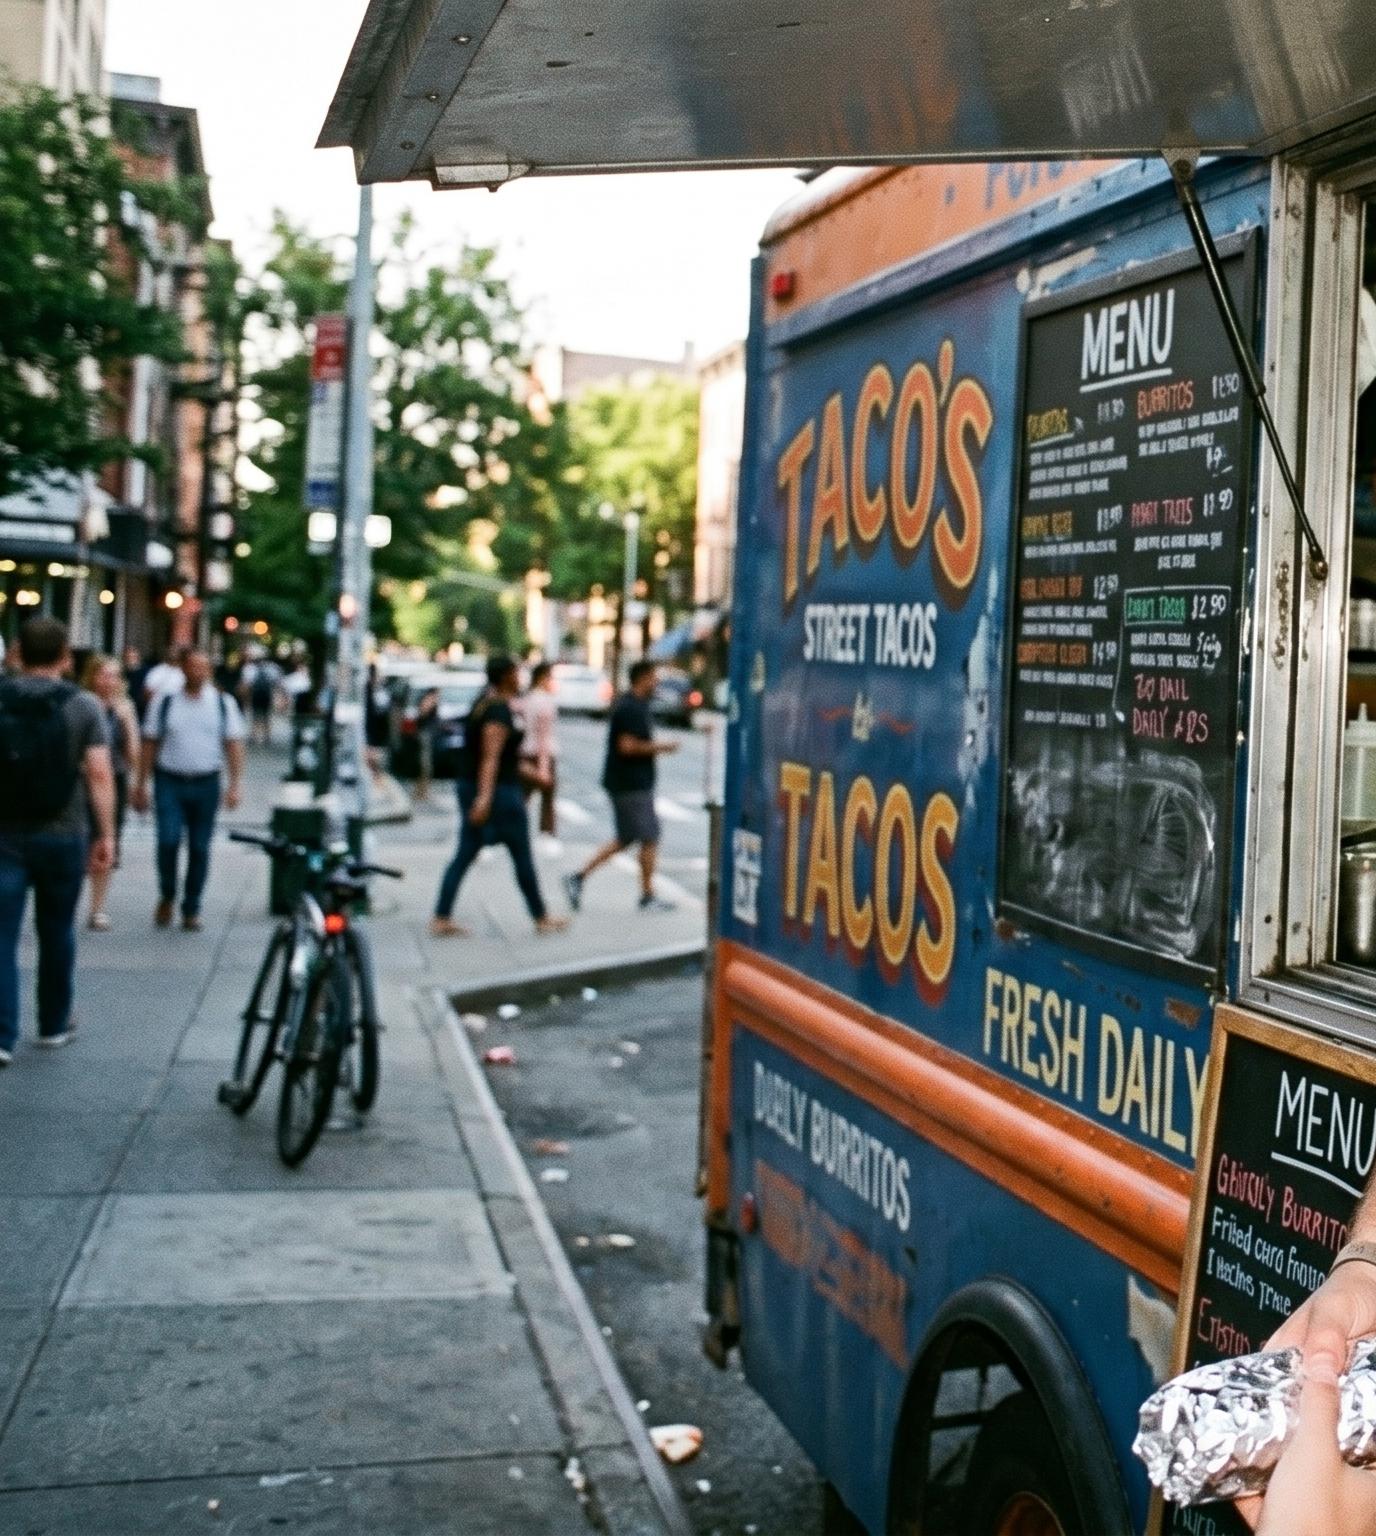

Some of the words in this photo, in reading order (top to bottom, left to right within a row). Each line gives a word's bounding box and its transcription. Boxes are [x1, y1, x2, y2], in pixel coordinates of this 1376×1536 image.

[1080, 288, 1175, 380] MENU
[778, 339, 993, 602] TACO'S
[803, 603, 870, 664] STREET
[874, 602, 937, 670] TACOS
[780, 762, 959, 987] TACOS
[984, 966, 1087, 1103] FRESH
[1098, 1013, 1211, 1159] DAILY
[811, 1099, 910, 1231] BURRITOS
